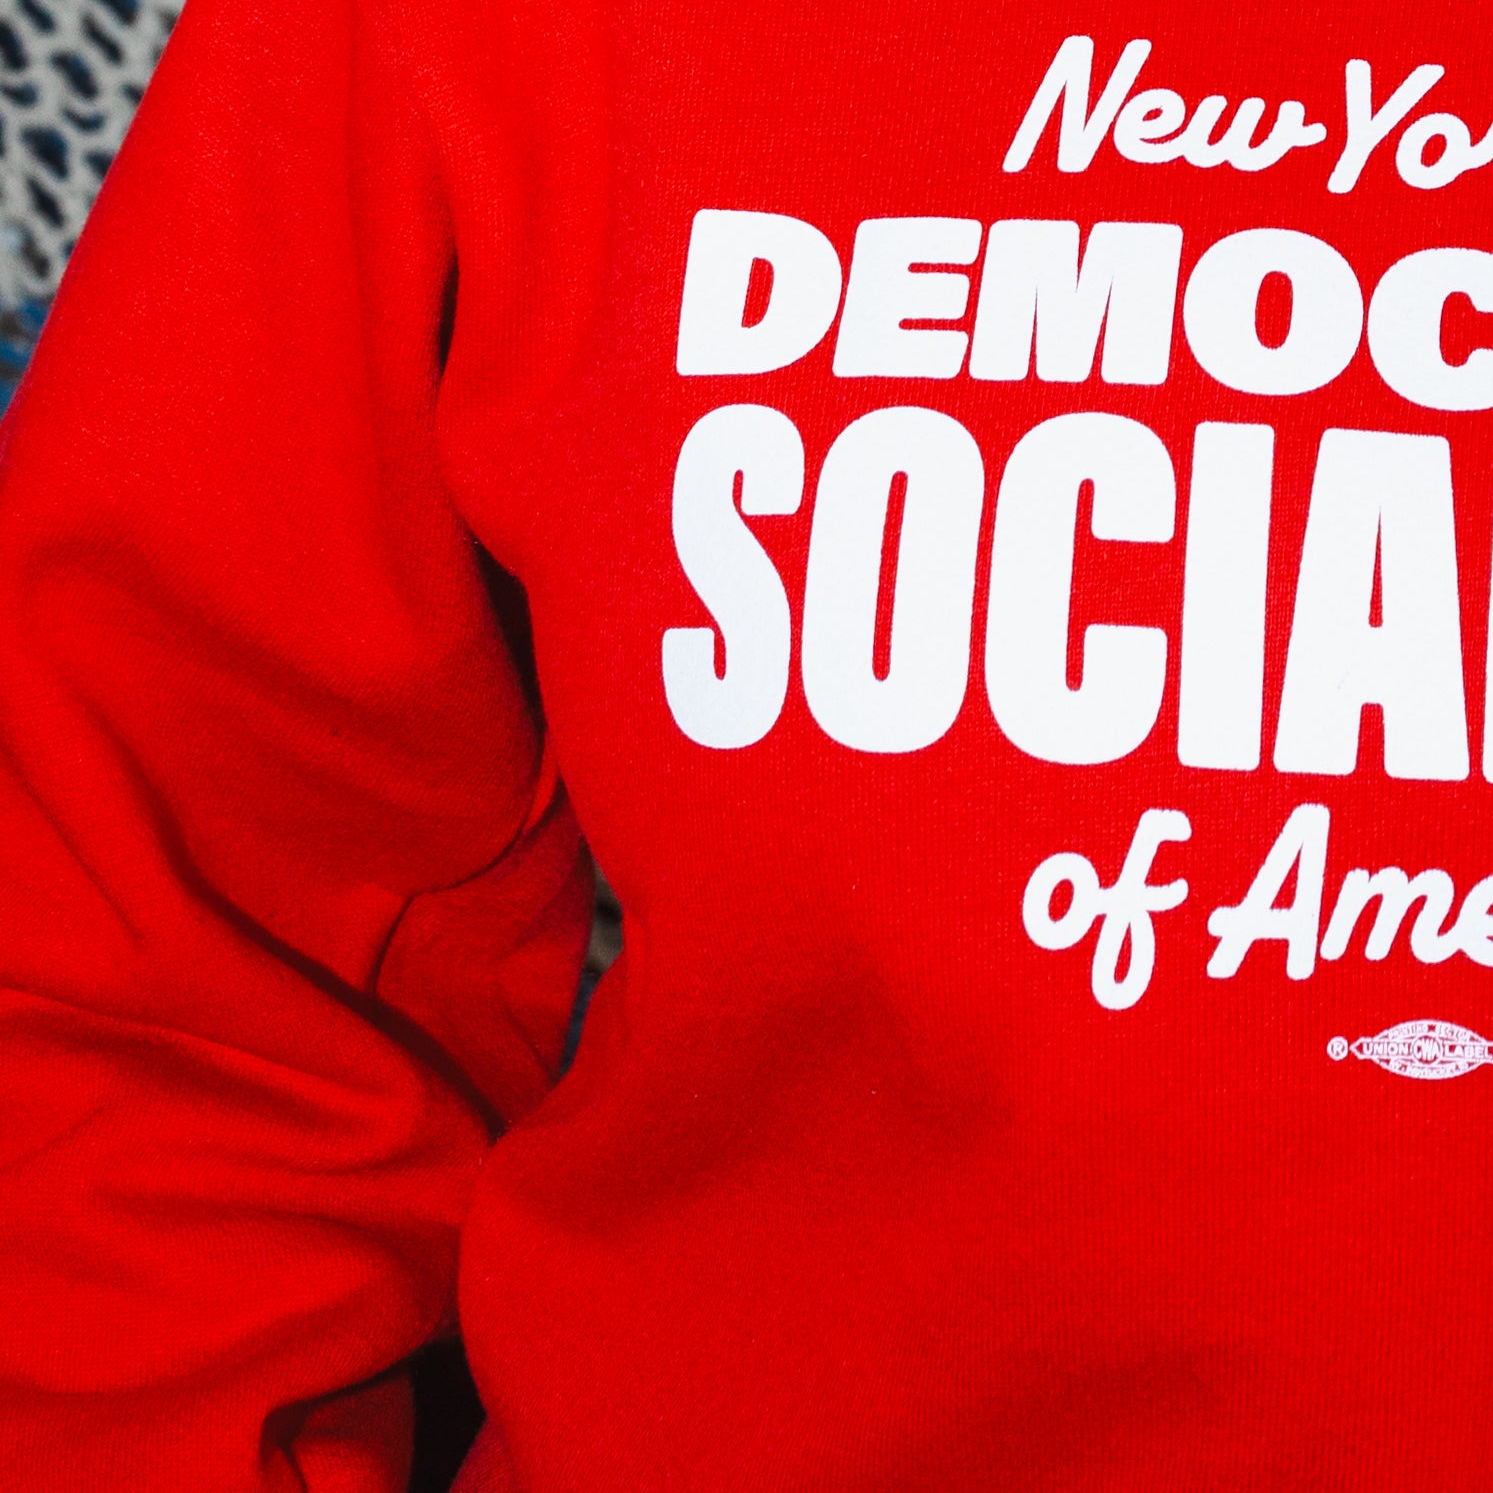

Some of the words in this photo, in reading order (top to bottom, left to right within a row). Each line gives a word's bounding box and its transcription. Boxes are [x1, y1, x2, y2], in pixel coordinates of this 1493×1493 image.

[1002, 35, 1327, 173] New
[1022, 808, 1192, 1011] of
[1362, 1041, 1410, 1058] UNION
[1444, 1042, 1493, 1060] LABEL
